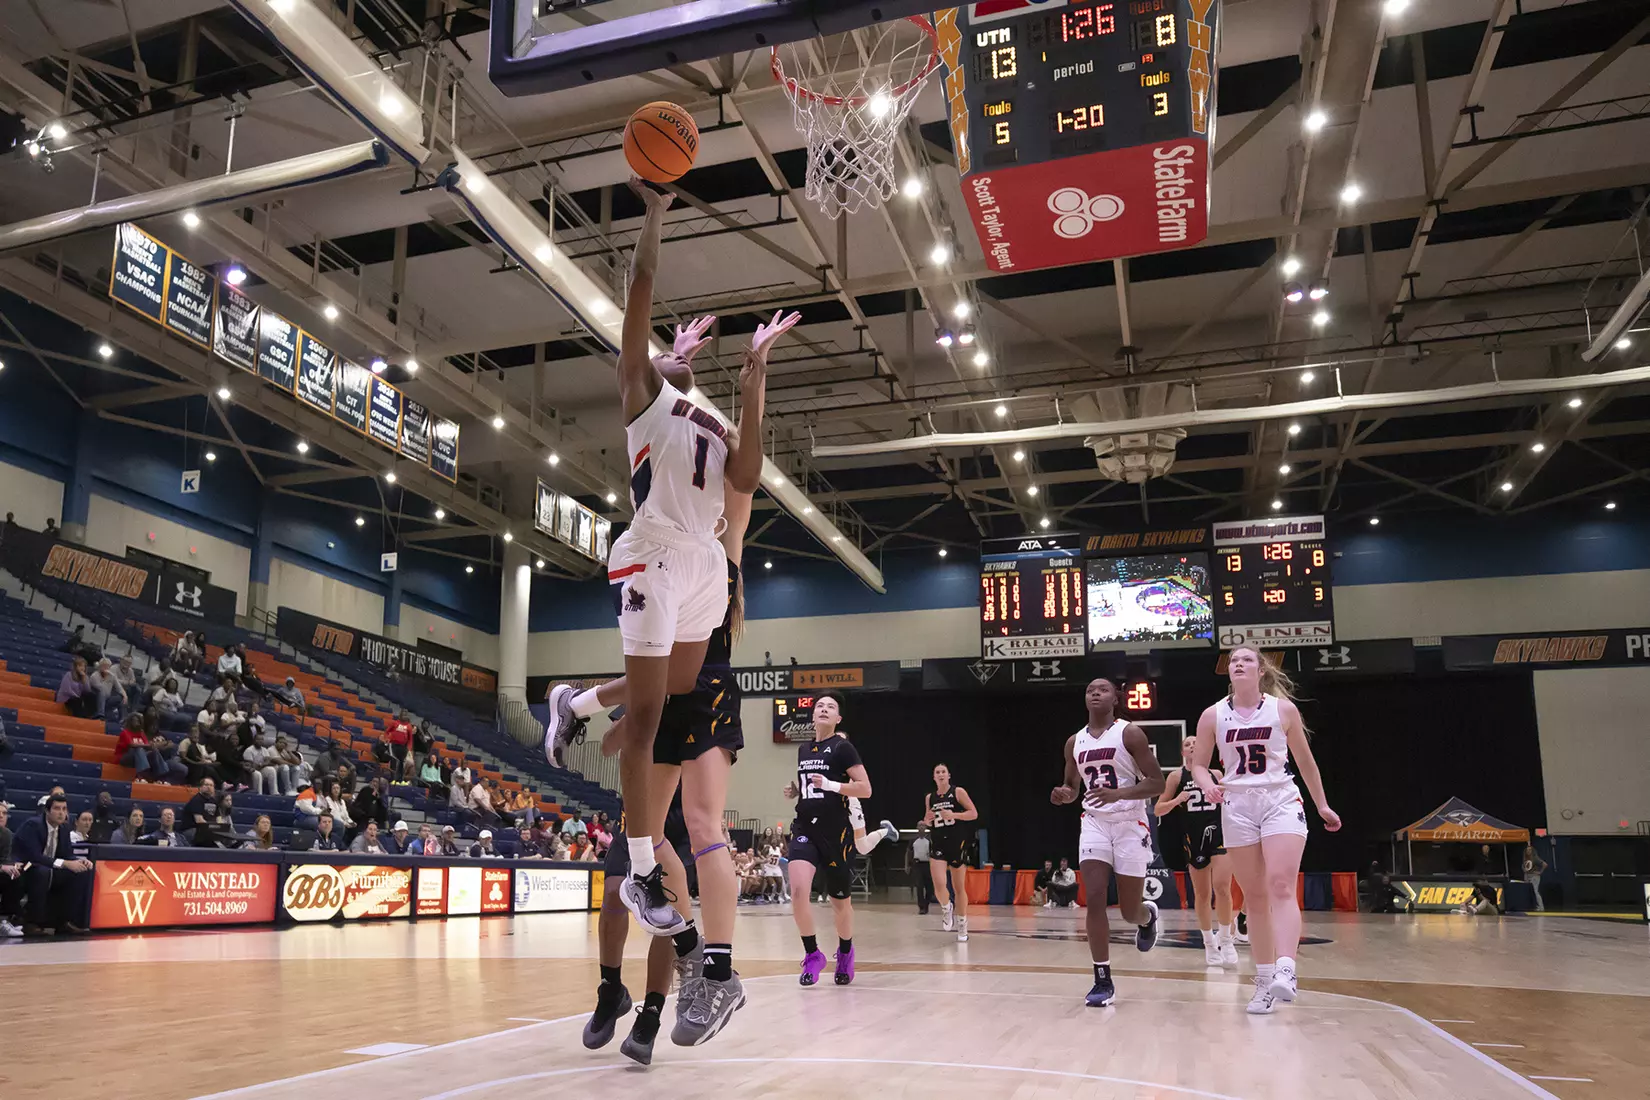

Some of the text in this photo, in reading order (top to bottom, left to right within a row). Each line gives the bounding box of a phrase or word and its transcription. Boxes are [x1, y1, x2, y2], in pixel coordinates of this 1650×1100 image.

[1061, 3, 1115, 42] 1:26
[1155, 13, 1176, 46] 8
[976, 27, 1011, 47] UTM
[991, 46, 1017, 79] 13
[1053, 60, 1094, 81] period
[1140, 70, 1170, 87] fouls
[983, 101, 1012, 117] fouls
[1153, 92, 1168, 116] 3
[995, 121, 1010, 144] 5
[972, 177, 1016, 270] Scott Taylor, Agent
[127, 261, 156, 287] VSAC
[180, 262, 206, 284] 1982
[115, 271, 161, 304] CHAMPIONS
[176, 292, 206, 316] NCAA
[228, 291, 251, 312] 1983
[168, 300, 211, 329] TOURNAMENT
[227, 322, 246, 340] GSC
[269, 345, 288, 362] GSC
[308, 340, 329, 358] 2009
[260, 353, 295, 377] CHAMPIONS
[346, 395, 358, 407] CIT
[692, 433, 710, 491] 1
[184, 478, 195, 491] K
[1018, 540, 1043, 550] ATA
[1086, 528, 1206, 551] UT MARTIN SKYHAWKS
[1263, 543, 1293, 560] 1:26
[1313, 550, 1325, 567] 8
[384, 560, 393, 569] L
[984, 561, 1017, 571] SKYHAWKS
[1049, 557, 1073, 567] Guests
[1227, 555, 1242, 571] 13
[41, 544, 149, 600] SKYHAWKS
[1224, 592, 1234, 606] 5
[1315, 587, 1323, 601] 3
[1493, 636, 1609, 664] SKYHAWKS
[1128, 690, 1151, 709] 26
[1226, 726, 1273, 743] UT MARTIN
[1078, 748, 1117, 764] UT MARTIN
[1235, 744, 1267, 775] 15
[1084, 764, 1119, 789] 23
[800, 773, 825, 799] 12
[1452, 829, 1504, 839] MARTIN
[173, 872, 260, 890] WINSTEAD
[531, 876, 552, 891] West
[552, 876, 588, 891] Tennessee
[172, 890, 186, 898] Real
[187, 890, 206, 898] Estate
[211, 890, 226, 898] Land
[287, 873, 341, 909] BB's
[1418, 887, 1446, 904] FAN
[184, 901, 248, 916] 731.504.8969
